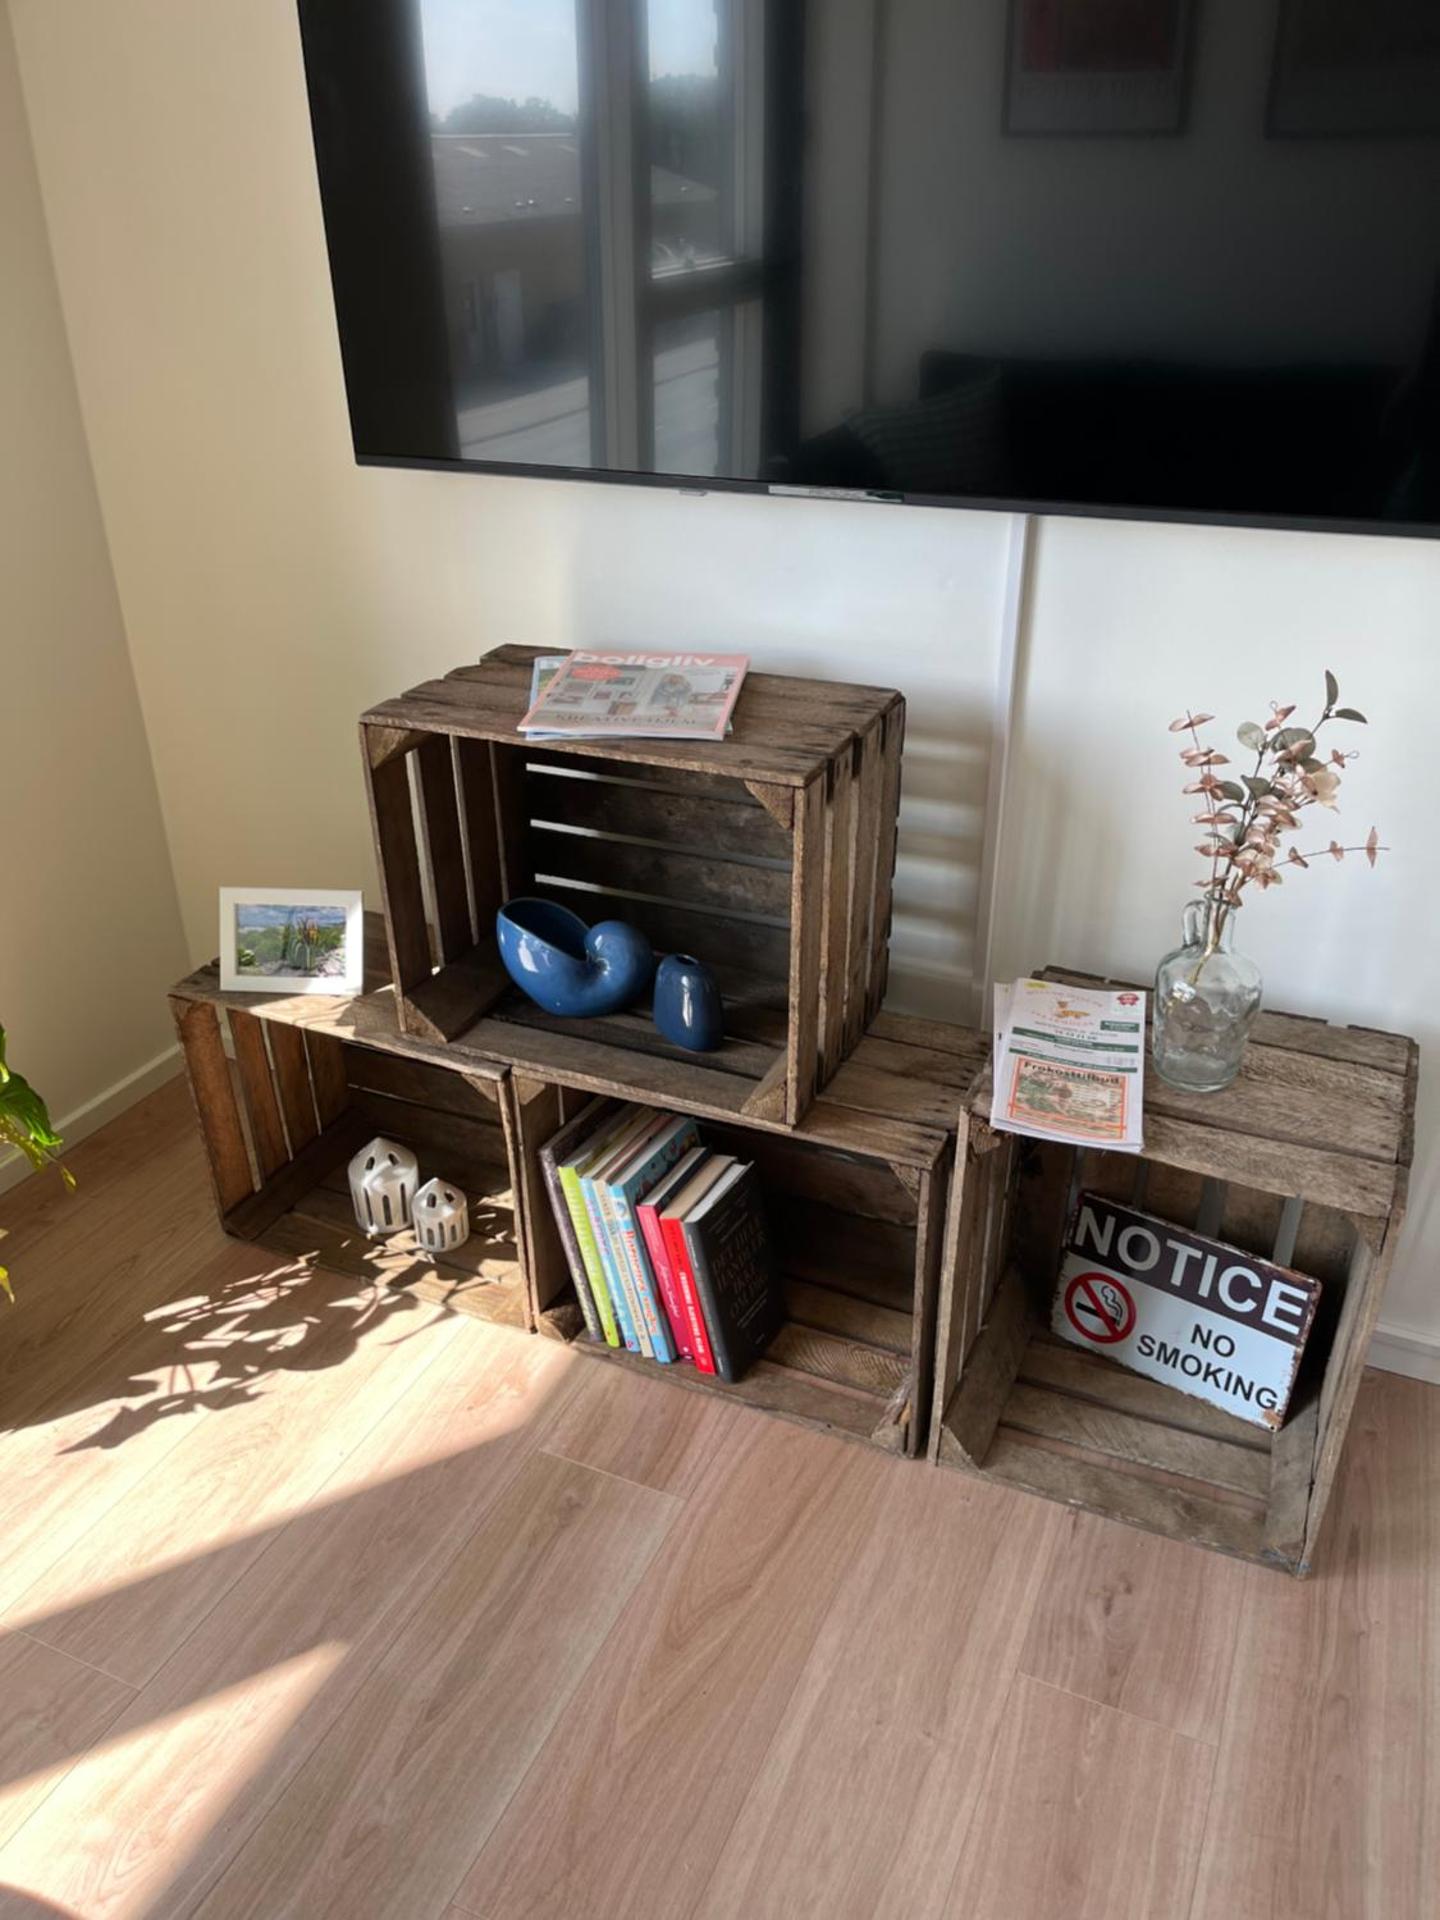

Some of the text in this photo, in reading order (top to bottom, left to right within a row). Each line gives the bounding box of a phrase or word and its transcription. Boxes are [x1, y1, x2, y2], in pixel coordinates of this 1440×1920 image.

[575, 652, 715, 669] boligliv
[1074, 1205, 1308, 1335] NOTICE
[1190, 1323, 1235, 1358] NO
[1137, 1334, 1279, 1410] SMOKING
